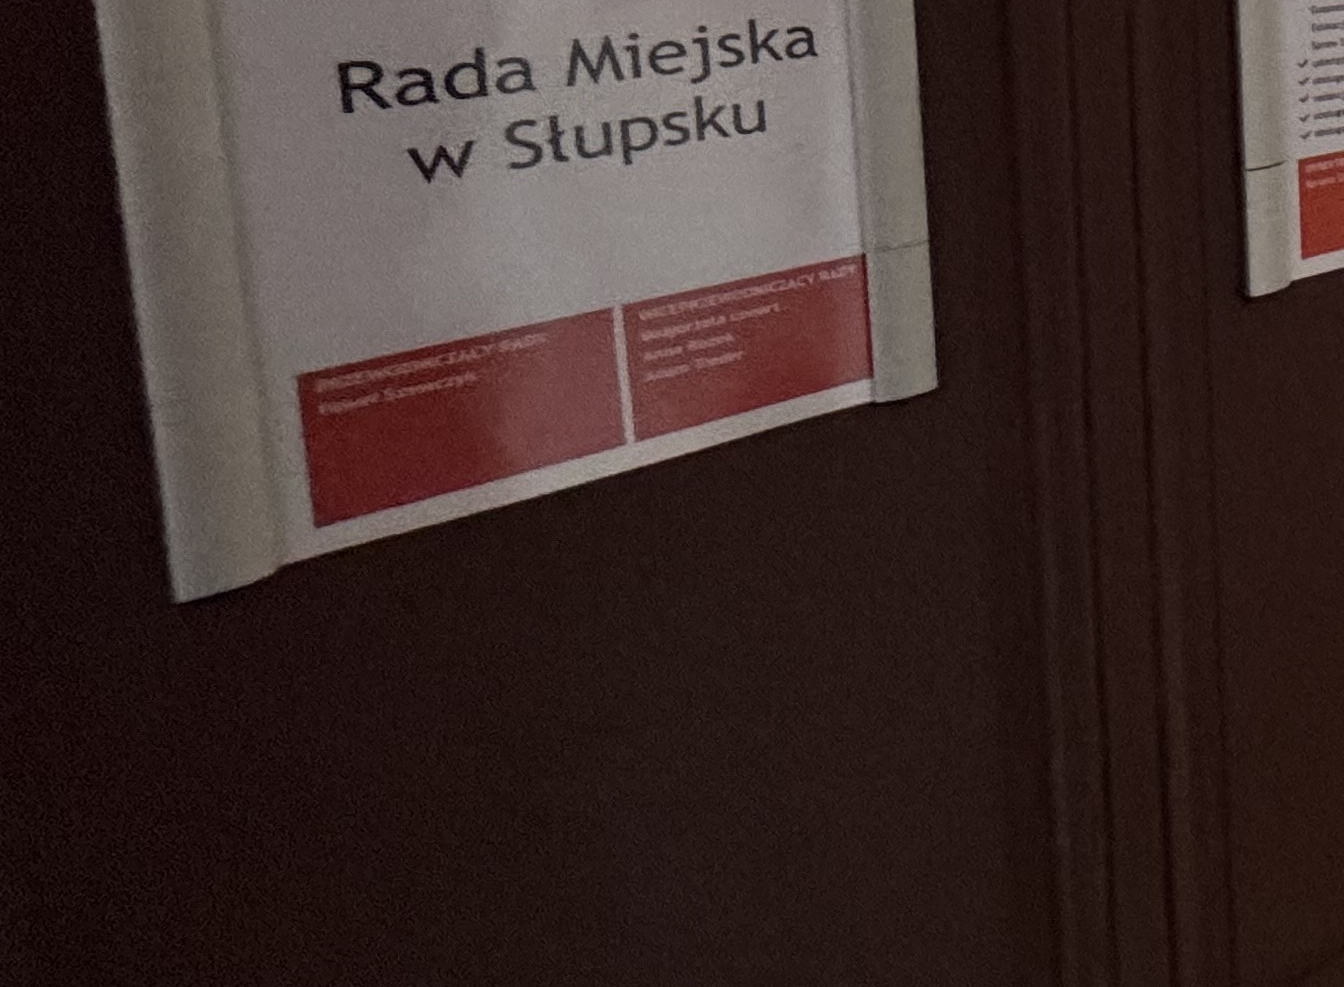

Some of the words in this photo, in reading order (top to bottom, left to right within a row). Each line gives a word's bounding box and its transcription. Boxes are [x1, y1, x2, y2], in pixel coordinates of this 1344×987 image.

[337, 46, 536, 114] Rada
[566, 18, 819, 86] Miejska
[406, 139, 476, 185] w
[504, 94, 768, 171] Słupsku
